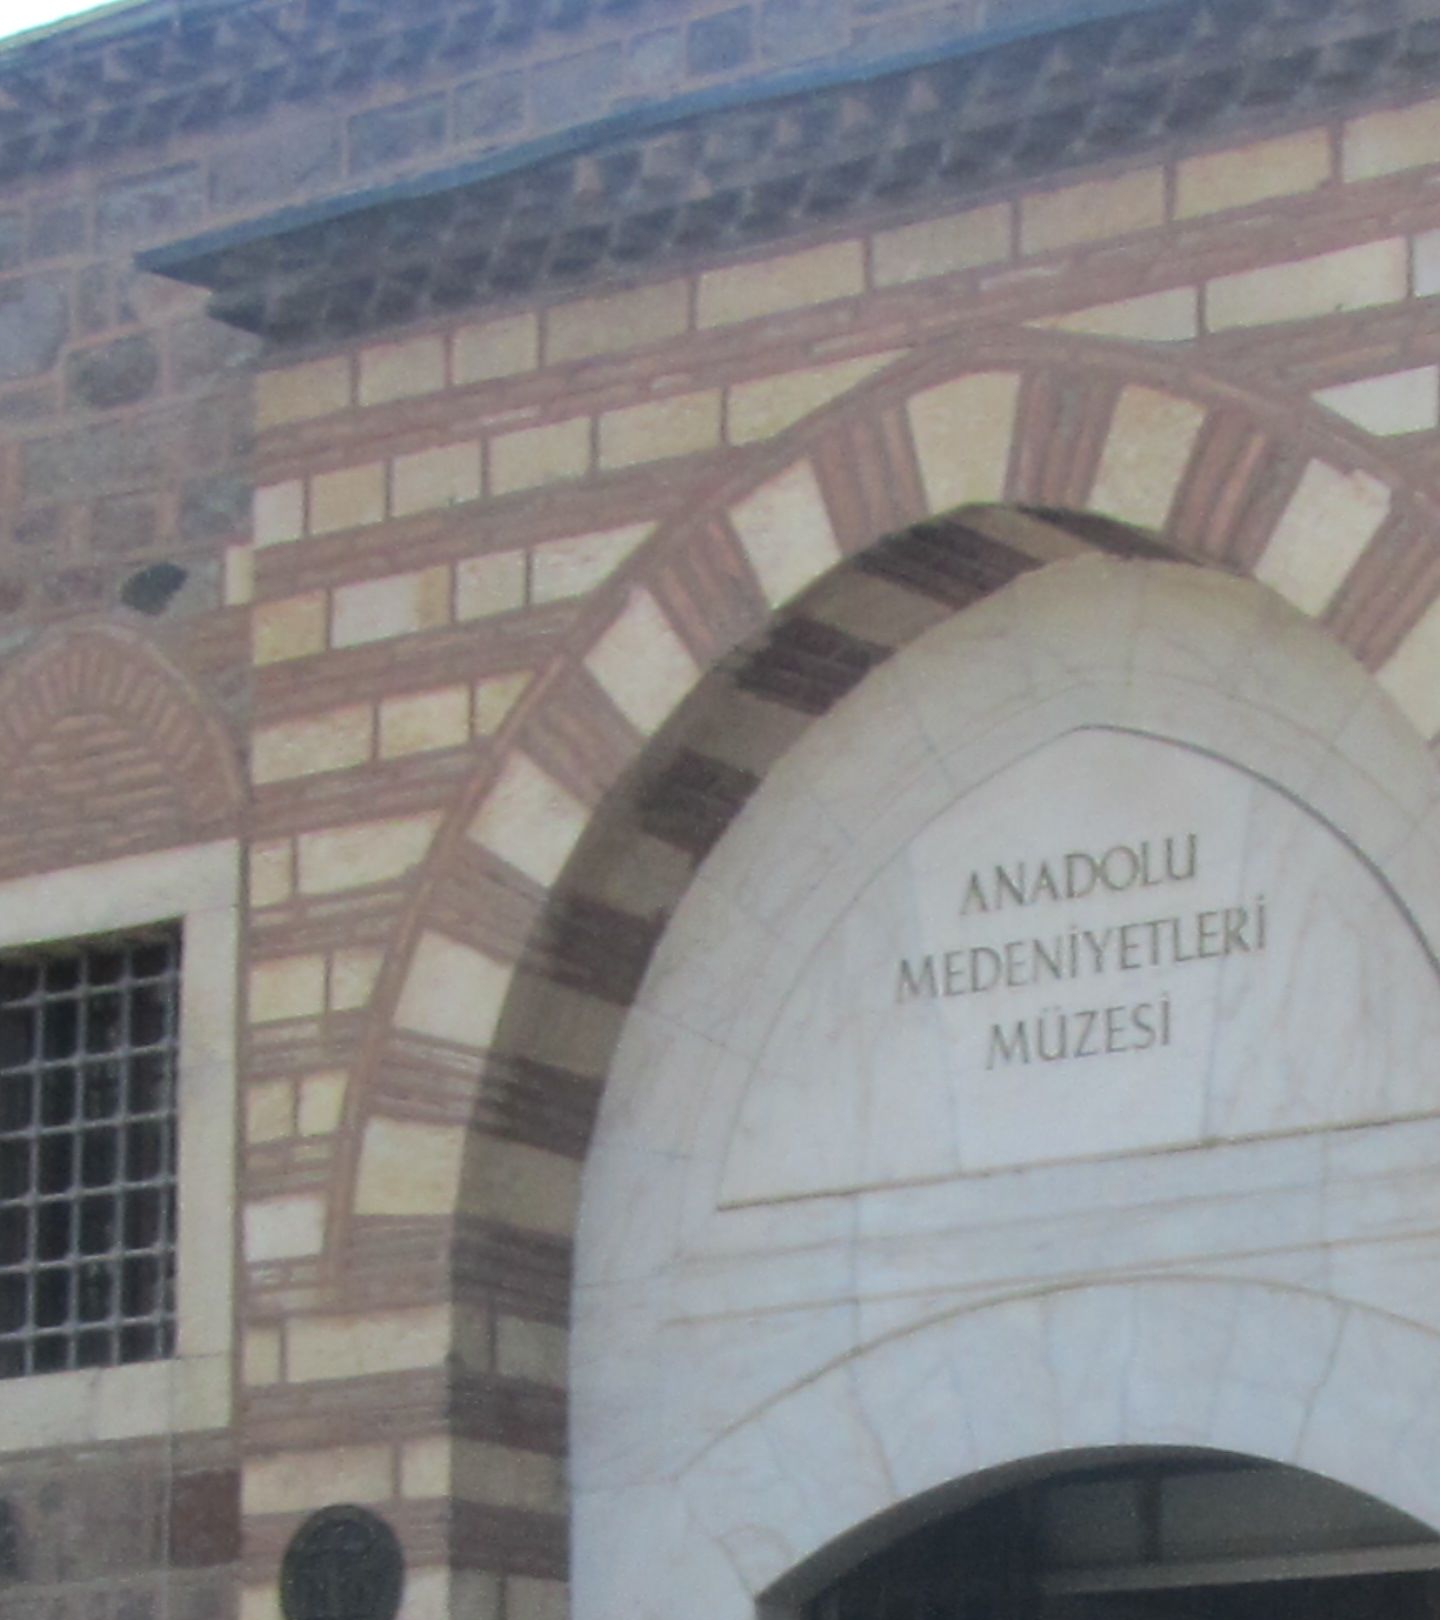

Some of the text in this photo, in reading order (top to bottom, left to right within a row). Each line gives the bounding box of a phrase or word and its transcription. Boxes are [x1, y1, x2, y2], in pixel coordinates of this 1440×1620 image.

[961, 832, 1198, 915] ANADOLU
[896, 895, 1267, 1003] MEDENİYETLERİ
[985, 993, 1172, 1070] MÜZESİ
